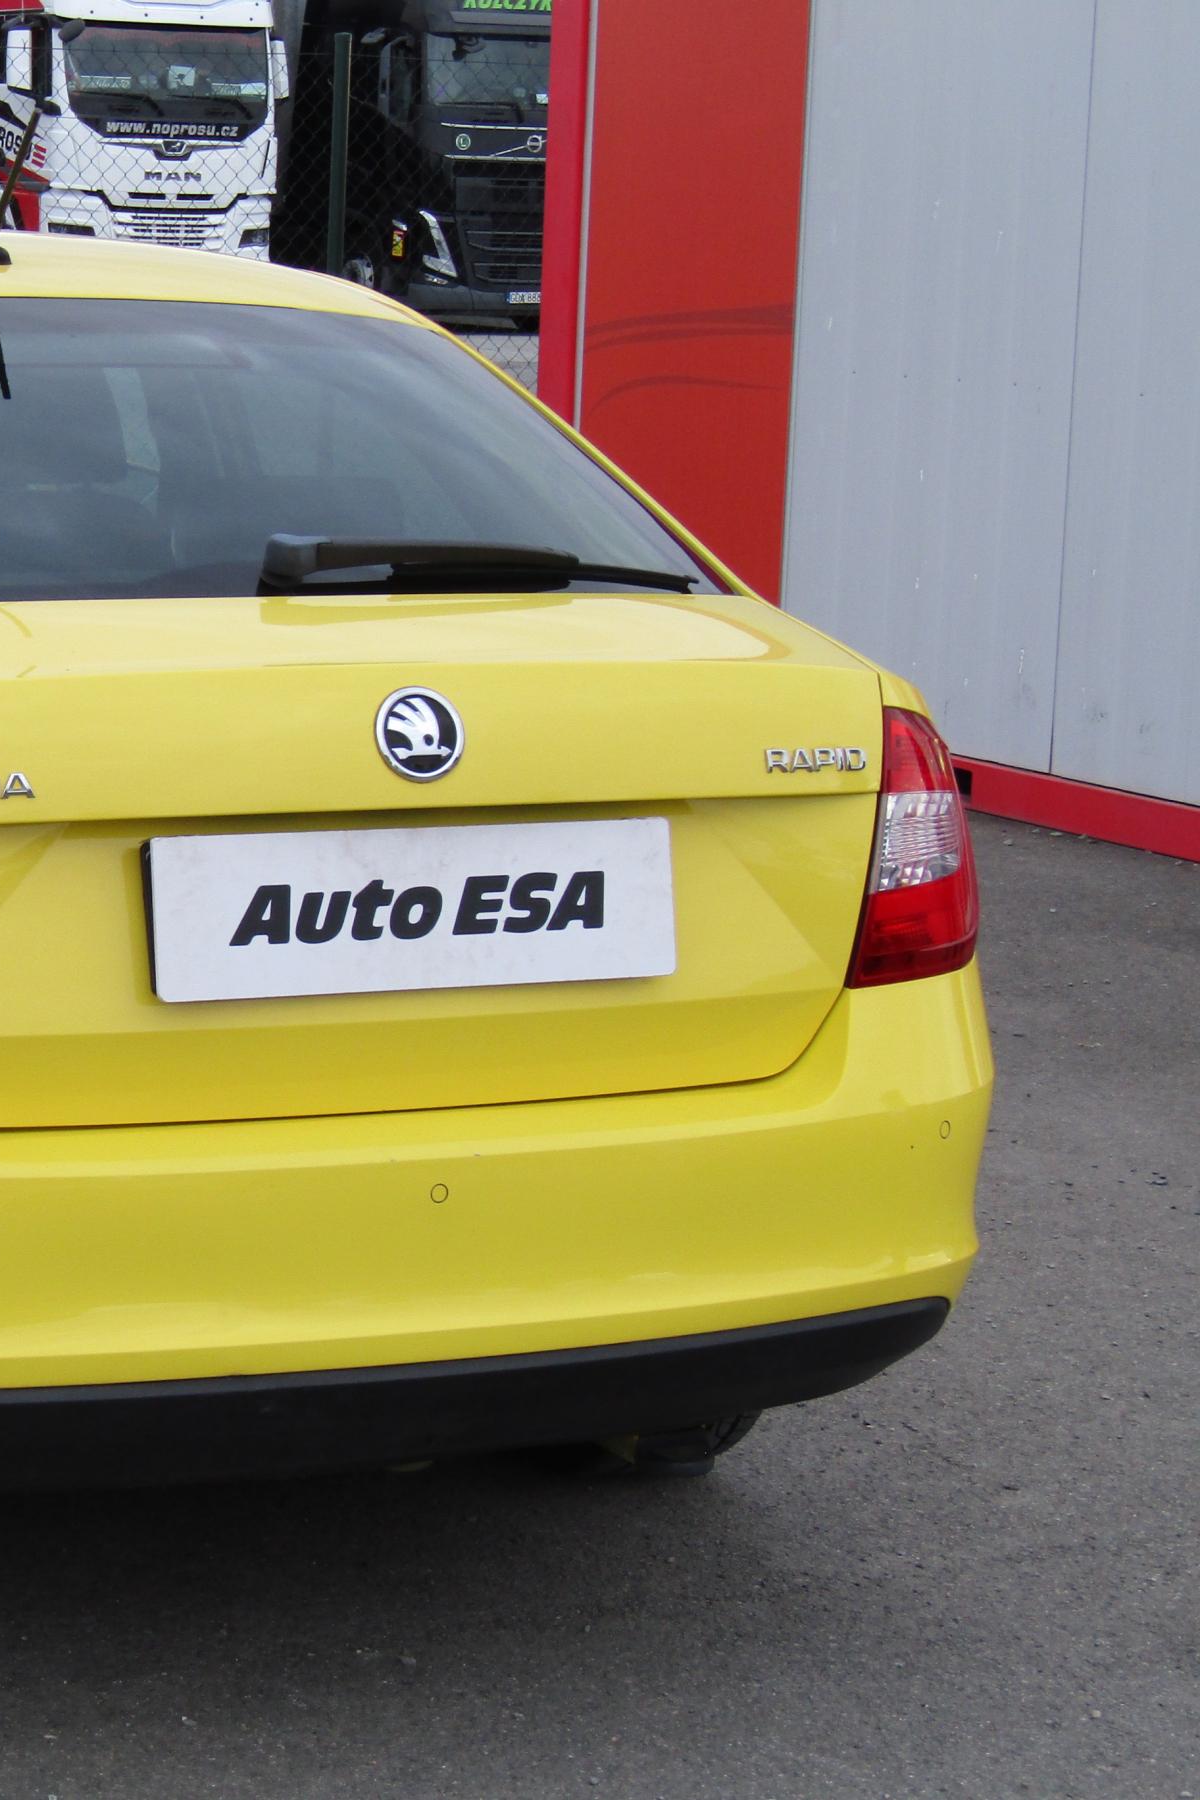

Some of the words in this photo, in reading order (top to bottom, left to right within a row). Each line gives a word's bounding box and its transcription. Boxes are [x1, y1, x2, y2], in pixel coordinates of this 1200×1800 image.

[106, 121, 238, 137] www.noprosu.cz
[144, 170, 202, 181] MAN
[766, 747, 867, 773] RAPID
[229, 879, 443, 947] Auto
[452, 870, 605, 936] ESA
